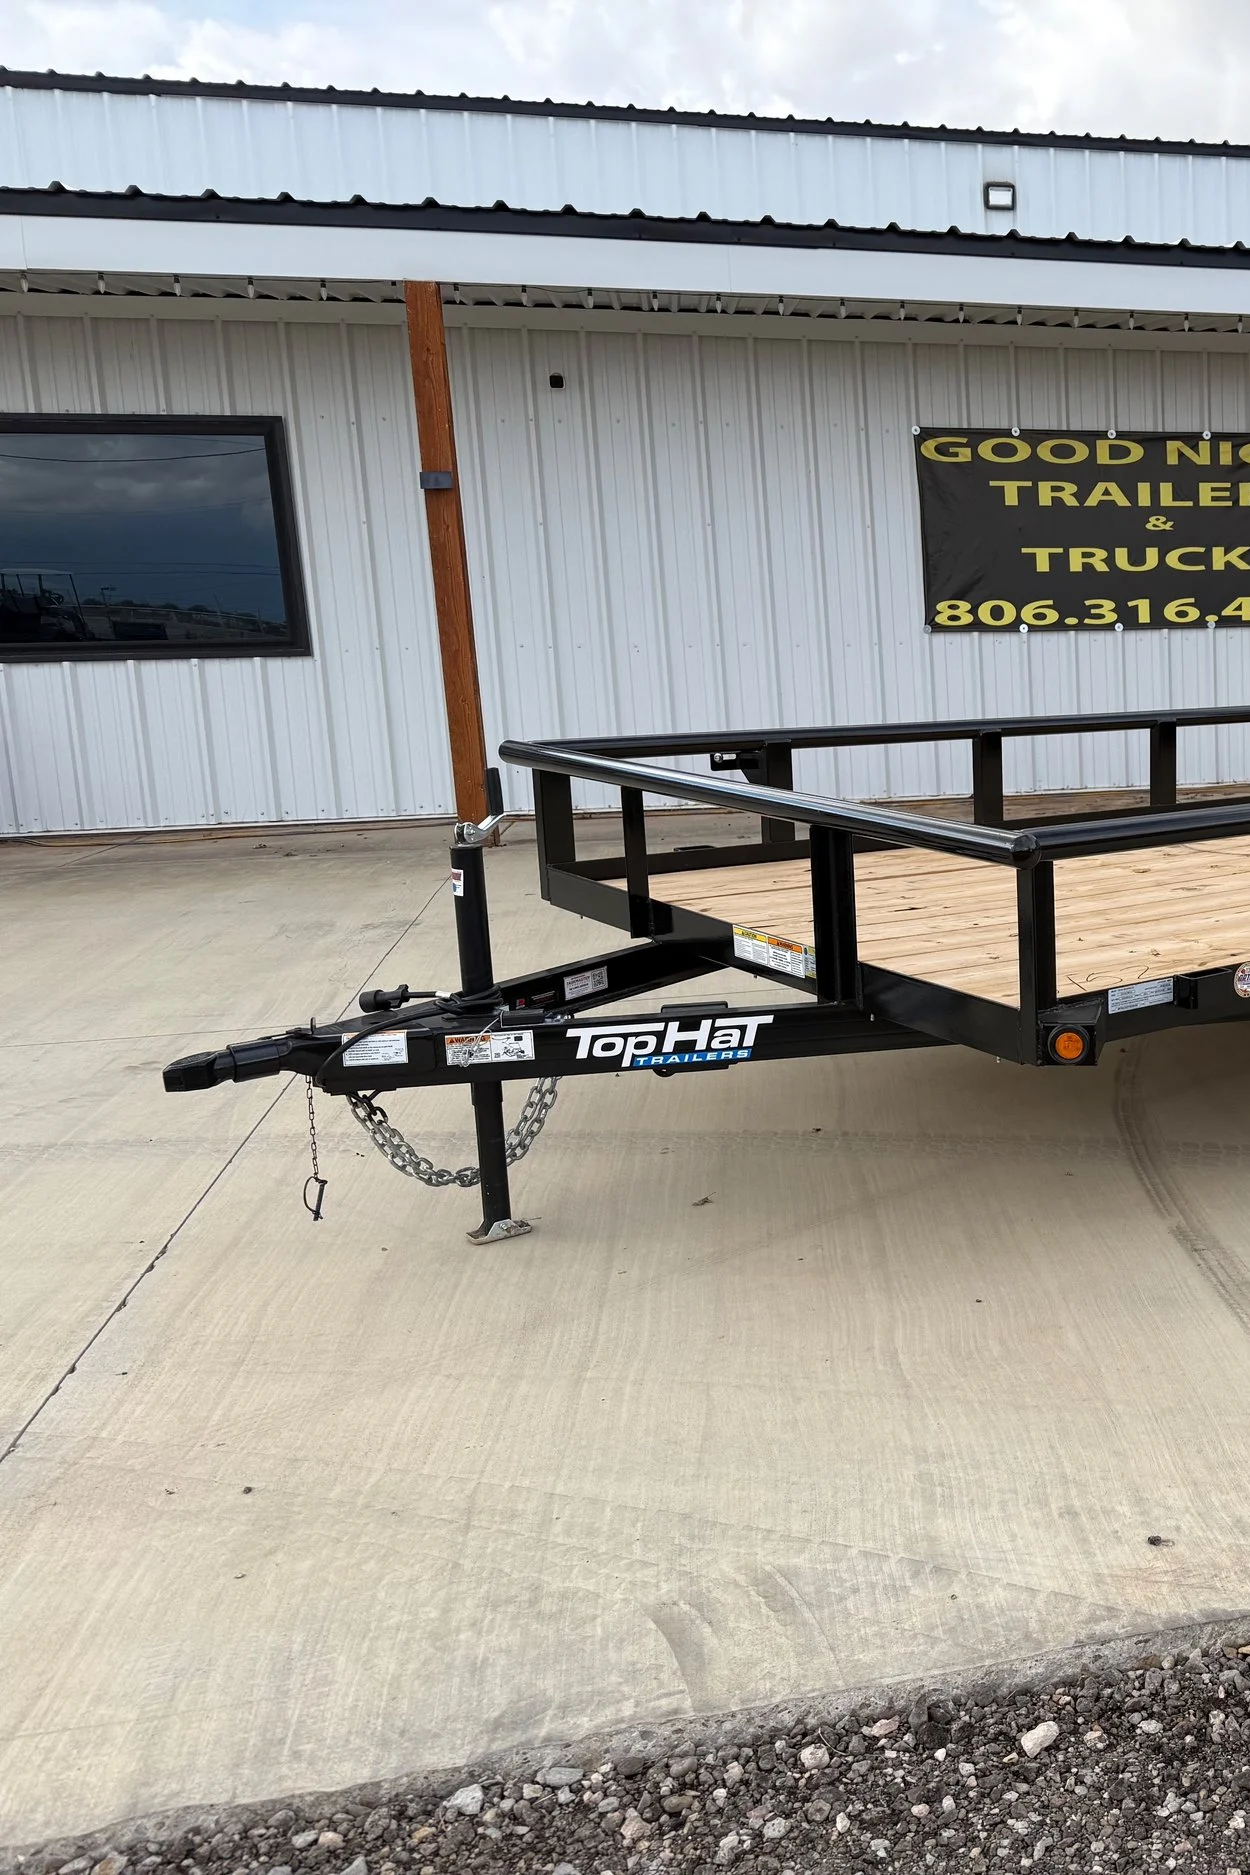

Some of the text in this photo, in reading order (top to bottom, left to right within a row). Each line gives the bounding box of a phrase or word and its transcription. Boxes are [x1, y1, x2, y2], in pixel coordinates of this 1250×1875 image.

[920, 436, 1145, 465] GOOD
[1145, 515, 1174, 531] &
[636, 1049, 749, 1066] TRAILERS
